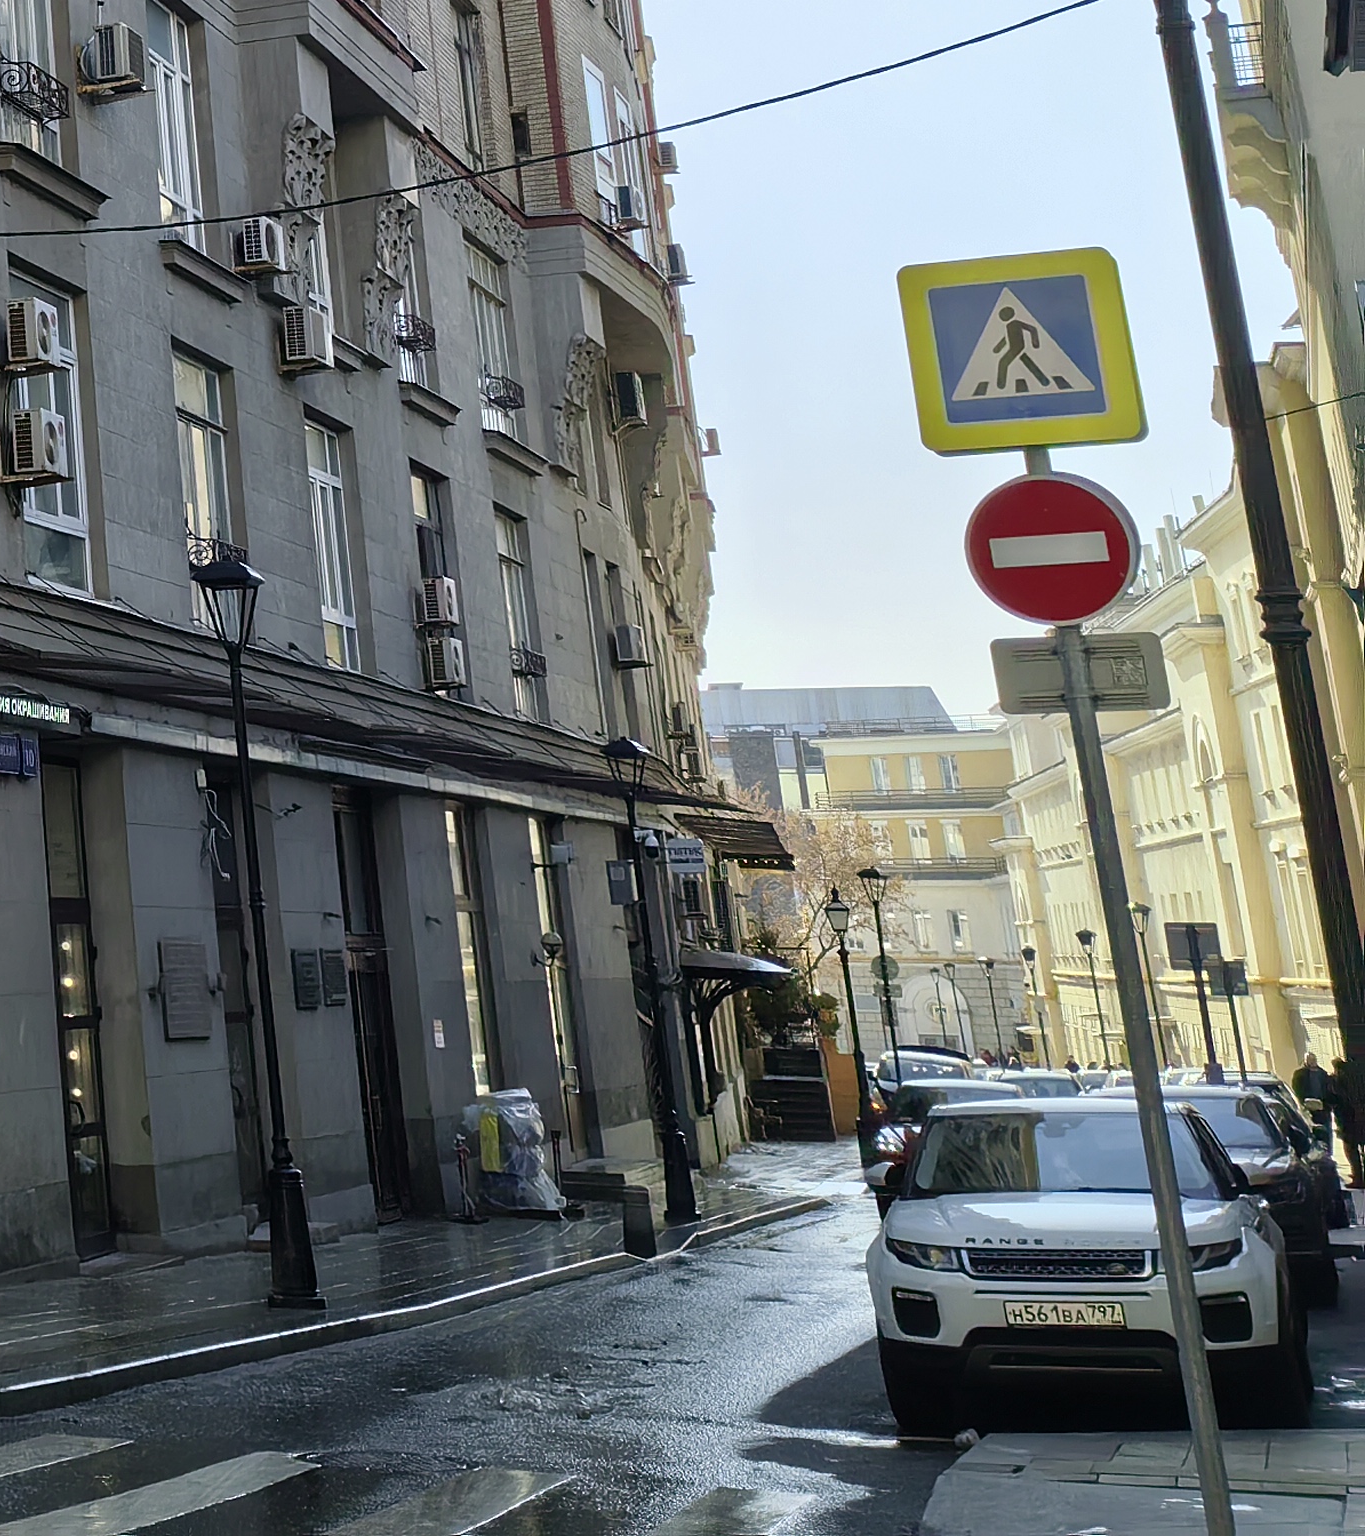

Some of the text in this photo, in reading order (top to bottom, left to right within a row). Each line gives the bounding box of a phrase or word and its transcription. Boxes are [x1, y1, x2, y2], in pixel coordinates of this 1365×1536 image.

[11, 698, 70, 724] ОКРАШИВАНИЯ
[25, 749, 35, 767] 10
[965, 1237, 1045, 1245] RANGE
[1086, 1304, 1116, 1320] 797
